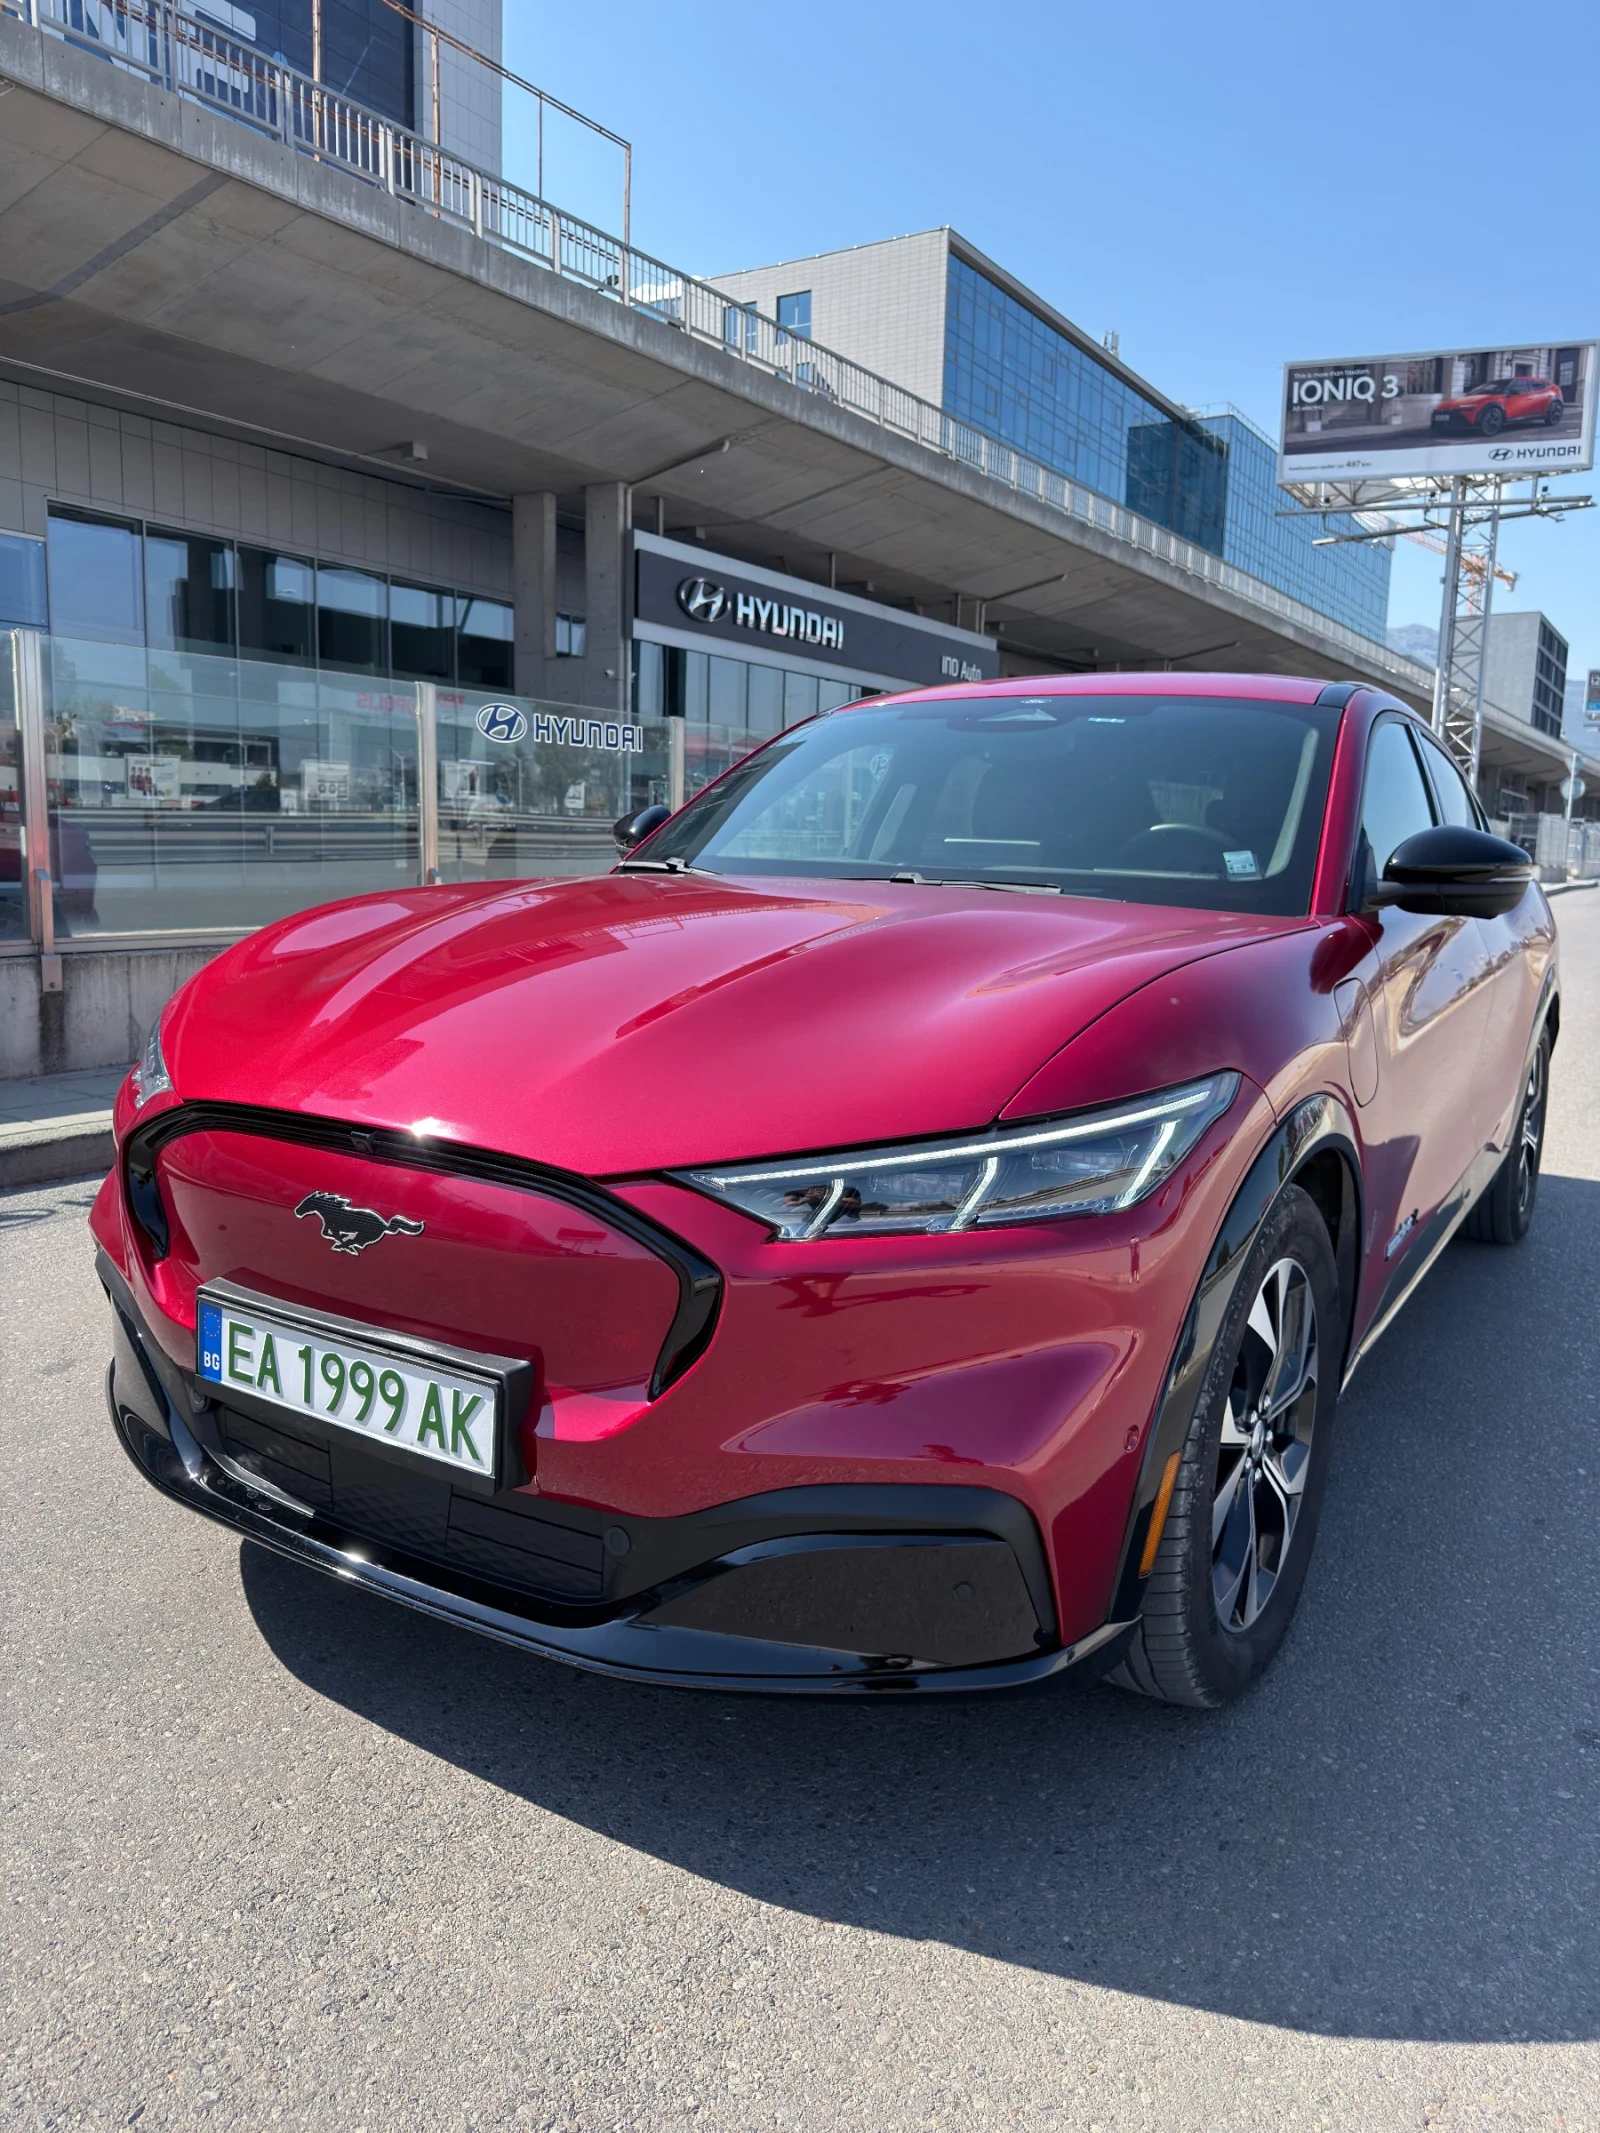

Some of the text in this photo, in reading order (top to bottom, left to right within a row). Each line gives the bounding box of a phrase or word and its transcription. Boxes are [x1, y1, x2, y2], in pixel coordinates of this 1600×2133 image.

[1292, 375, 1399, 404] IONIQ 3
[1517, 445, 1581, 458] HYUNDAI
[736, 592, 844, 650] HYUNDAI
[960, 661, 982, 682] Auto
[534, 713, 643, 753] HYUNDAI
[203, 1350, 221, 1372] BG
[227, 1318, 483, 1462] EA 1999 AK
